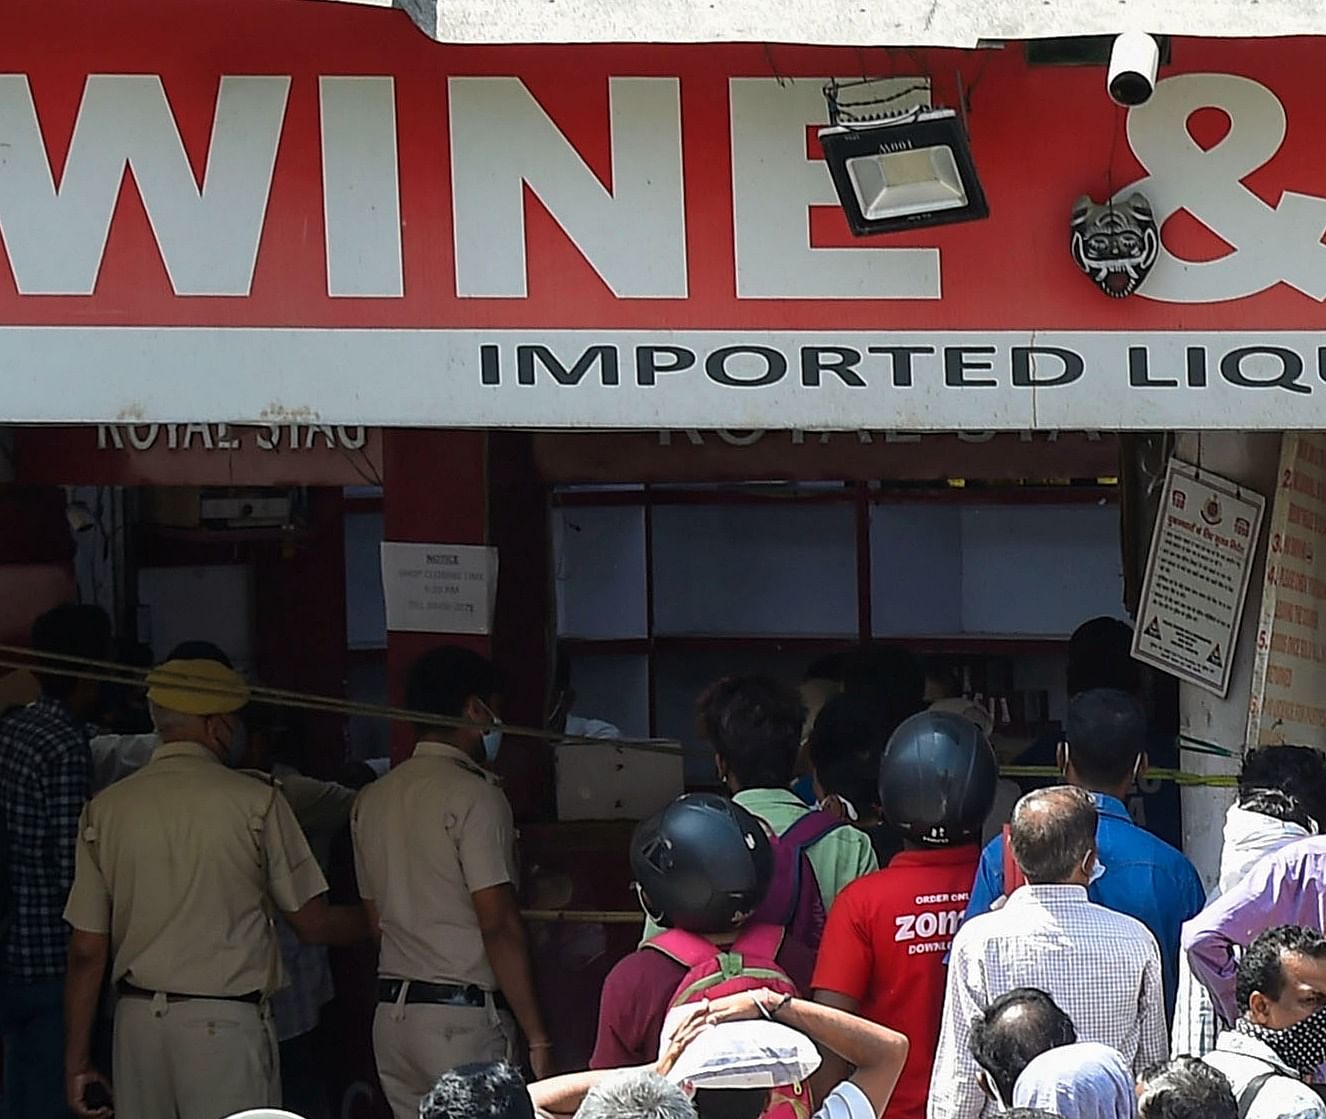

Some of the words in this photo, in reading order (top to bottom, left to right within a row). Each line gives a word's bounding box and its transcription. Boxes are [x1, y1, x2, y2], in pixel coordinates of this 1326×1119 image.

[0, 73, 942, 300] WINE
[479, 343, 1086, 388] IMPORTED
[915, 894, 949, 905] ORDER
[951, 892, 970, 902] ONL
[895, 910, 966, 942] zom
